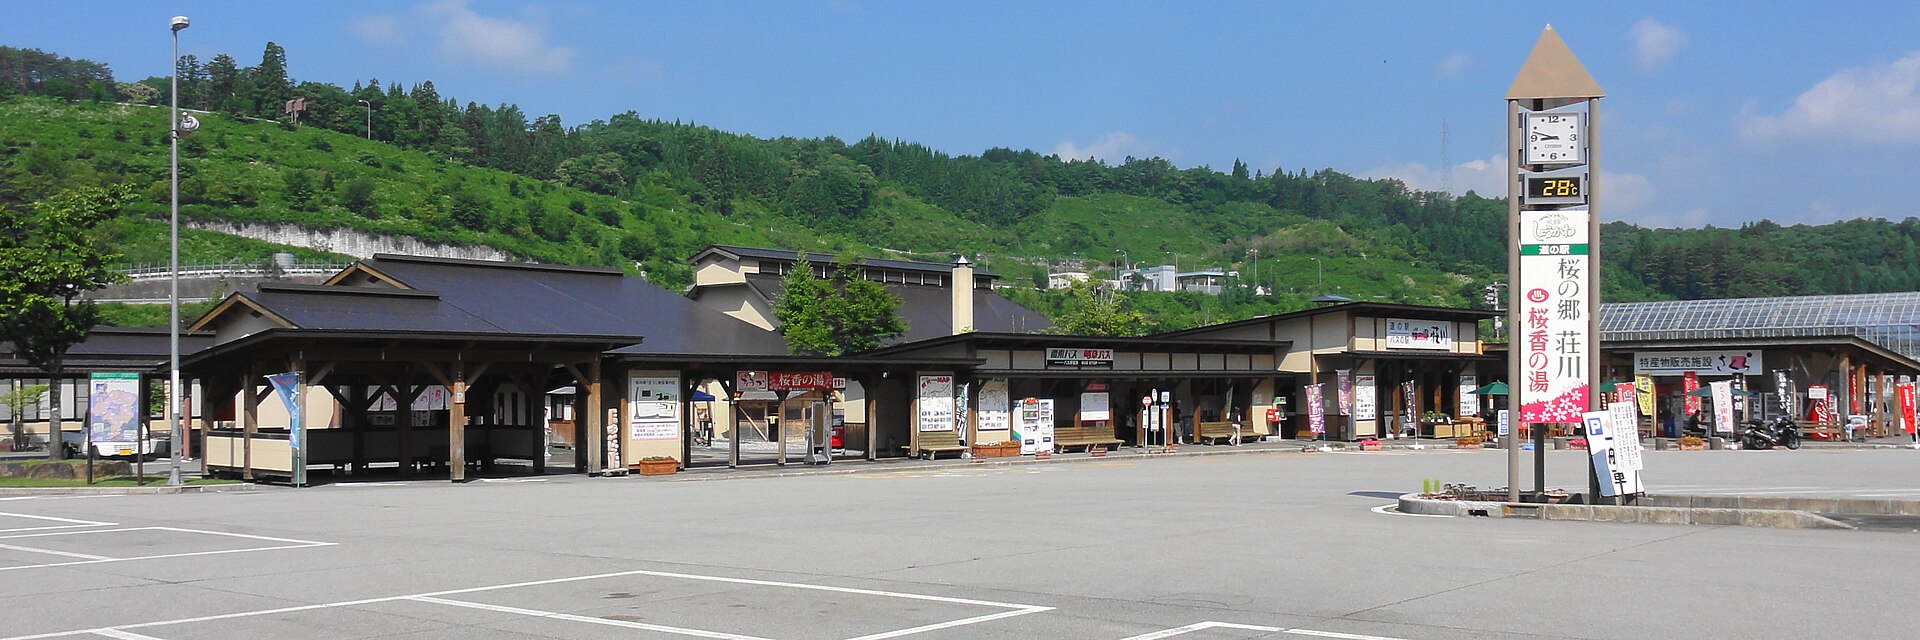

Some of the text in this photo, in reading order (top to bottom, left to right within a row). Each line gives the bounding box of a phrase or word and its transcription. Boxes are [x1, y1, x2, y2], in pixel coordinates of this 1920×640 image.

[1530, 134, 1538, 142] 9
[1550, 152, 1558, 160] 6
[1538, 244, 1570, 255] 道の駅
[1556, 258, 1581, 380] 桜の郷 荘川
[1528, 307, 1550, 393] 桜香の湯
[1640, 357, 1713, 368] 特産物販売施設
[779, 373, 824, 386] 桜香の湯
